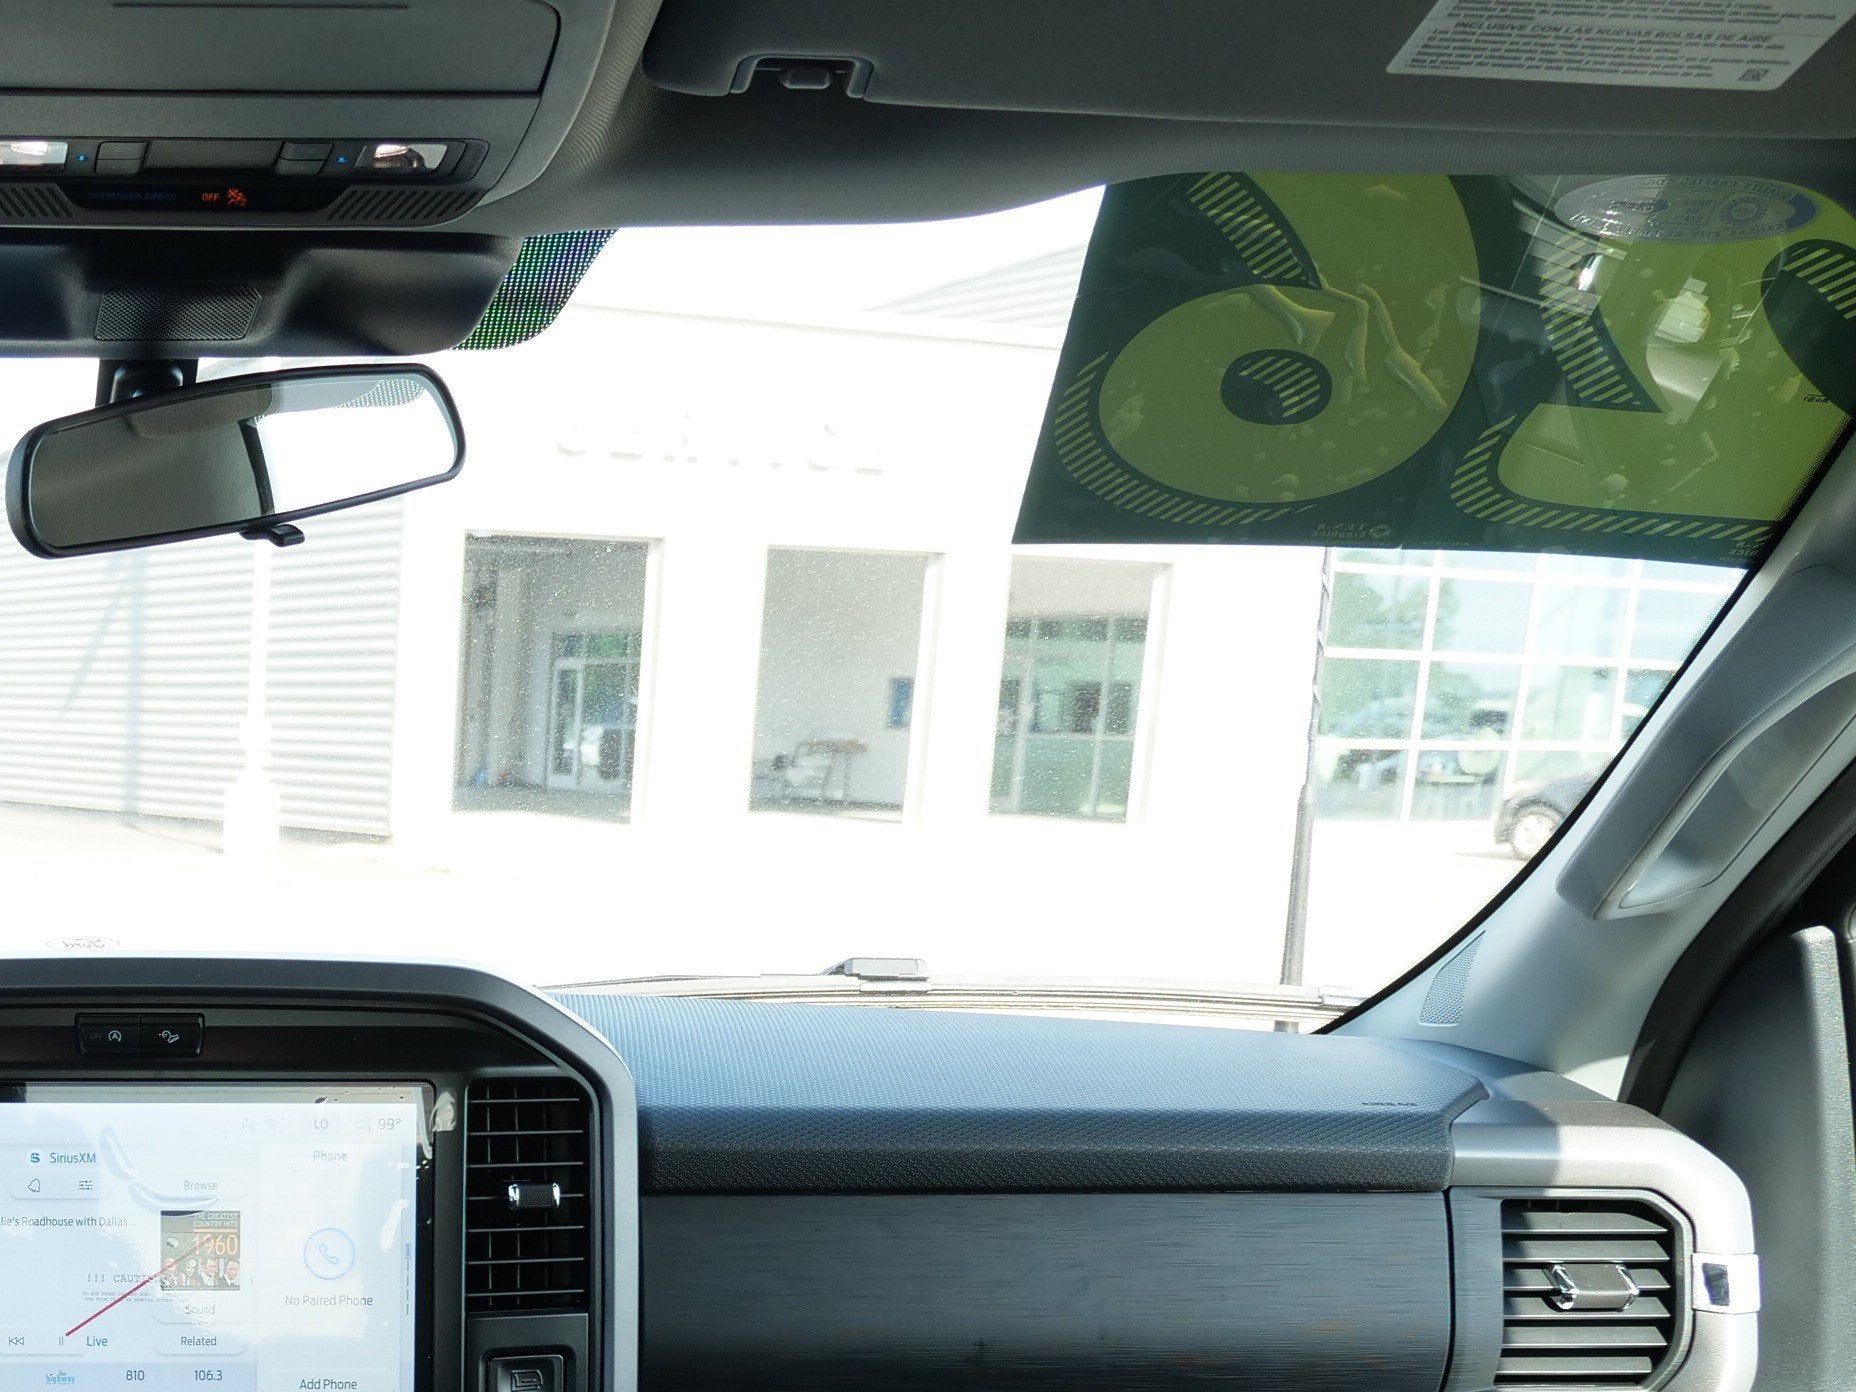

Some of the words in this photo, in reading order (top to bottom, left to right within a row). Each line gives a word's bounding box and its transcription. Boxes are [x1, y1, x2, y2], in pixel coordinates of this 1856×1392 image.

[1454, 21, 1528, 32] INCLUSIVE
[201, 192, 219, 201] OFF
[314, 1118, 328, 1129] LO
[49, 1151, 97, 1164] SiriusXM
[312, 1150, 347, 1162] Phone
[184, 1180, 218, 1191] Browse
[21, 1215, 74, 1227] Roadhouse
[75, 1215, 98, 1227] with
[207, 1212, 238, 1220] GREATEST
[193, 1234, 238, 1255] 1960
[285, 1295, 300, 1306] No
[302, 1295, 336, 1306] Paired
[338, 1295, 373, 1306] Phone
[185, 1304, 216, 1315] Sound
[86, 1336, 108, 1347] Live
[180, 1336, 217, 1347] Related
[125, 1369, 145, 1381] 810
[194, 1369, 223, 1381] 106.3
[299, 1379, 321, 1391] Add
[322, 1379, 358, 1391] Phone
